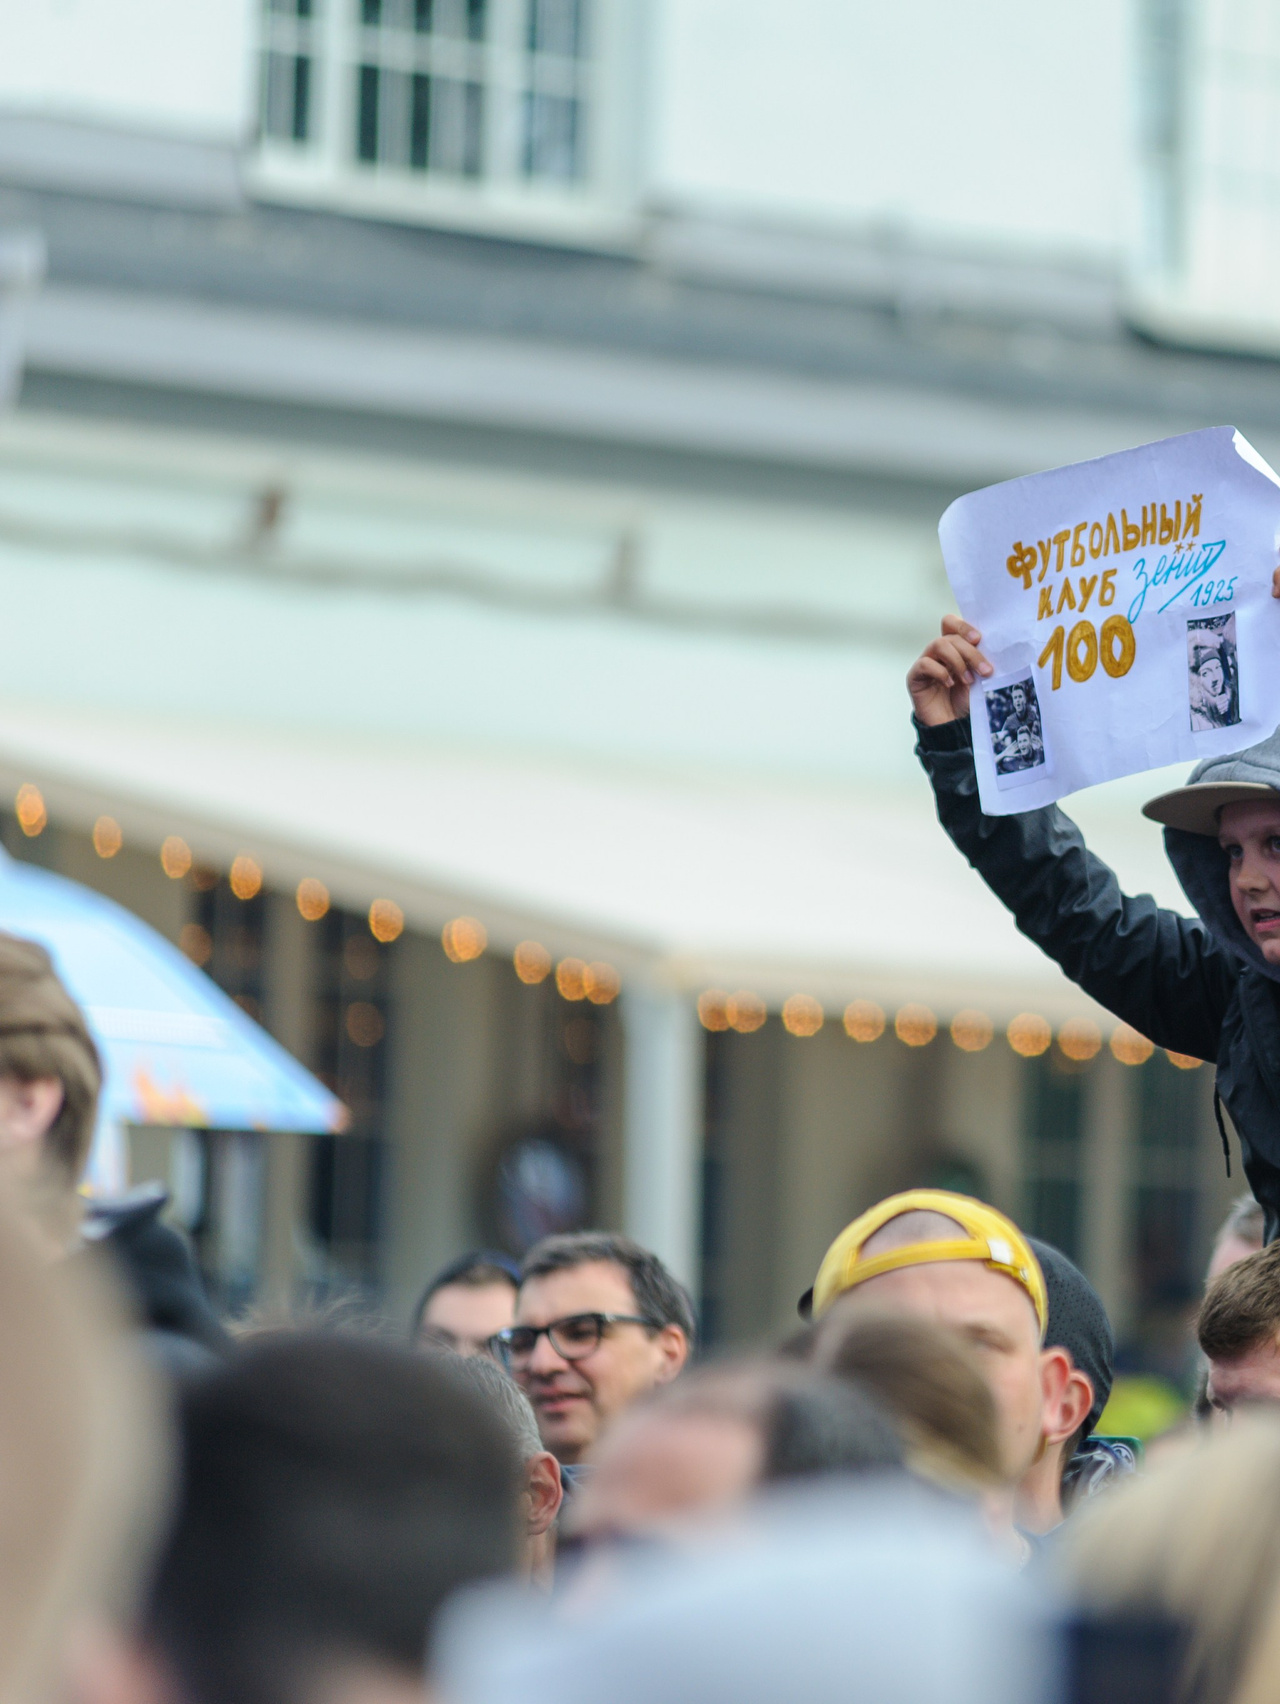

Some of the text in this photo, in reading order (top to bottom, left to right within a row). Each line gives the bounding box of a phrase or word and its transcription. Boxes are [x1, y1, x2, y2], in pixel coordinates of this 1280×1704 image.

[1006, 493, 1204, 590] ФУТБОЛЬНЫЙ
[1037, 568, 1118, 621] КЛУБ
[1190, 576, 1239, 607] 1925
[1037, 614, 1136, 691] 100
